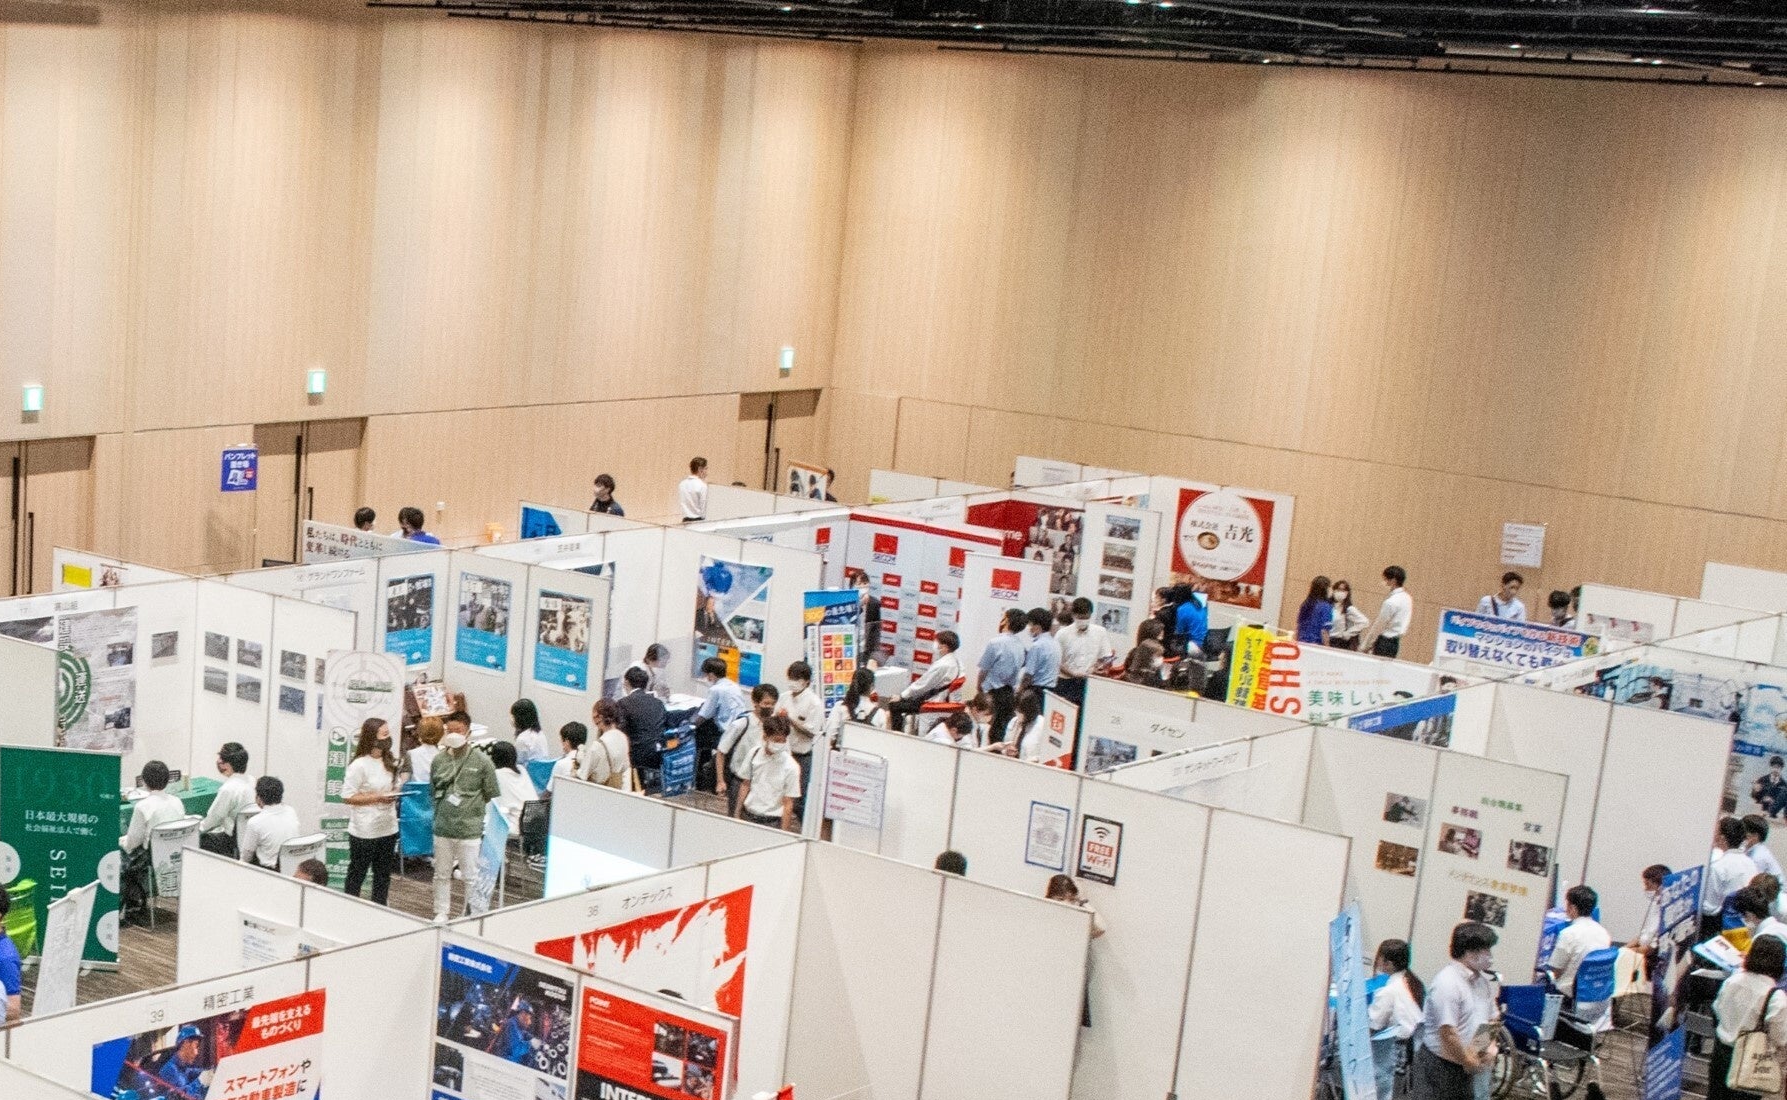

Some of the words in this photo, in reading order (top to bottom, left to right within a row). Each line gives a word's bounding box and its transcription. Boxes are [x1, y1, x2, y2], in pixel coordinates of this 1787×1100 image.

[1308, 690, 1384, 707] 美味しい
[25, 809, 99, 825] 日本最大規模の
[1087, 841, 1113, 857] FREE
[1085, 854, 1113, 869] Wi-Fi
[49, 849, 68, 902] SEI
[621, 886, 674, 909] オンテックス
[587, 905, 600, 918] 38
[203, 986, 256, 1010] 精密工業
[150, 1009, 165, 1024] 39
[223, 1058, 313, 1094] スマートフォンや
